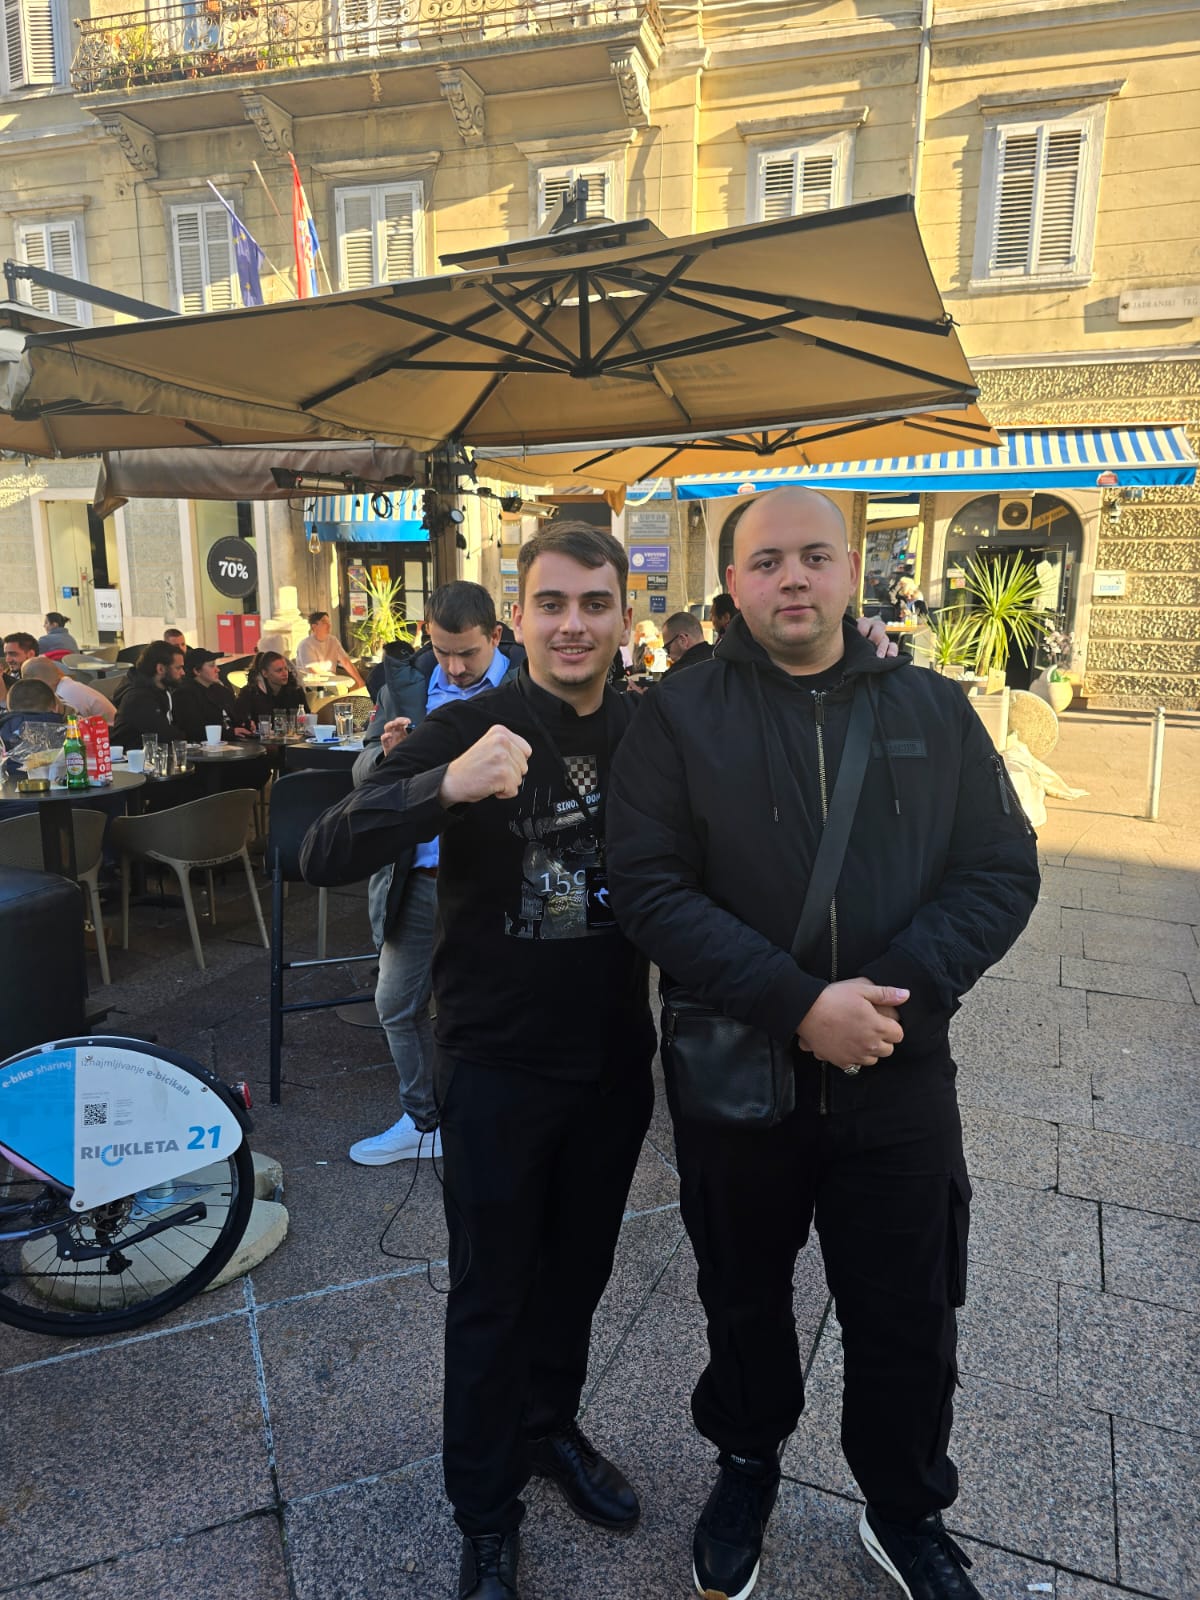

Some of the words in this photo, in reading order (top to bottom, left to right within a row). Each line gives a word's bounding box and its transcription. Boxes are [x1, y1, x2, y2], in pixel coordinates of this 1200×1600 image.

[218, 560, 249, 580] 70%
[2, 1069, 34, 1088] e-bike
[36, 1060, 72, 1075] sharing
[80, 1139, 180, 1167] RICIKLETA
[187, 1125, 222, 1150] 21
